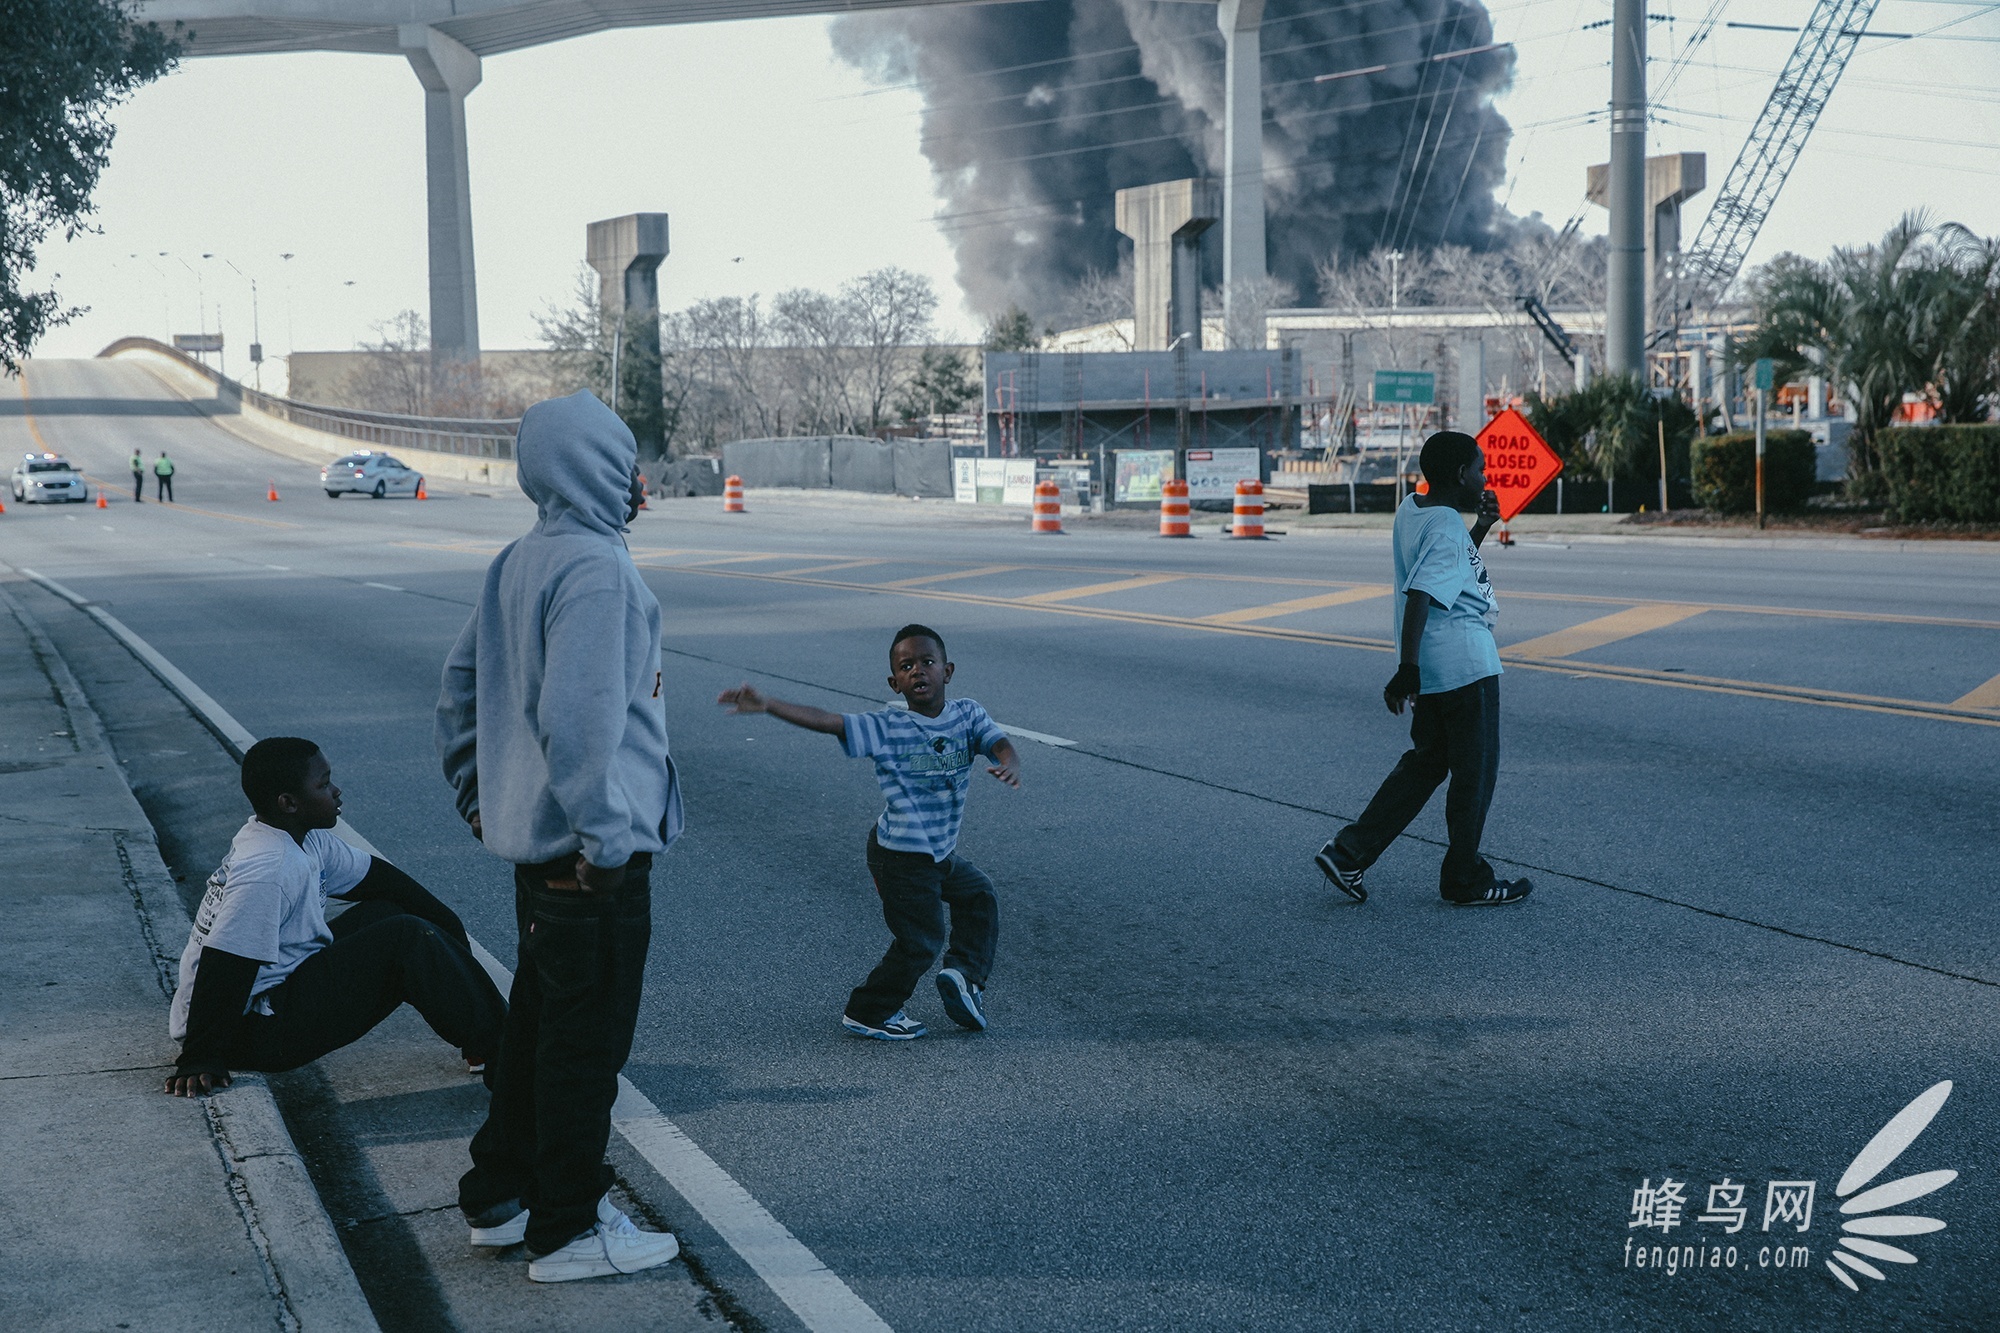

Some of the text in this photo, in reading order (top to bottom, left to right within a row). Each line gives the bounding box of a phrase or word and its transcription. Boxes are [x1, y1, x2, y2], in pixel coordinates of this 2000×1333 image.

[1487, 434, 1530, 451] ROAD
[1484, 453, 1537, 470] LOSED
[1484, 473, 1531, 489] AHEAD
